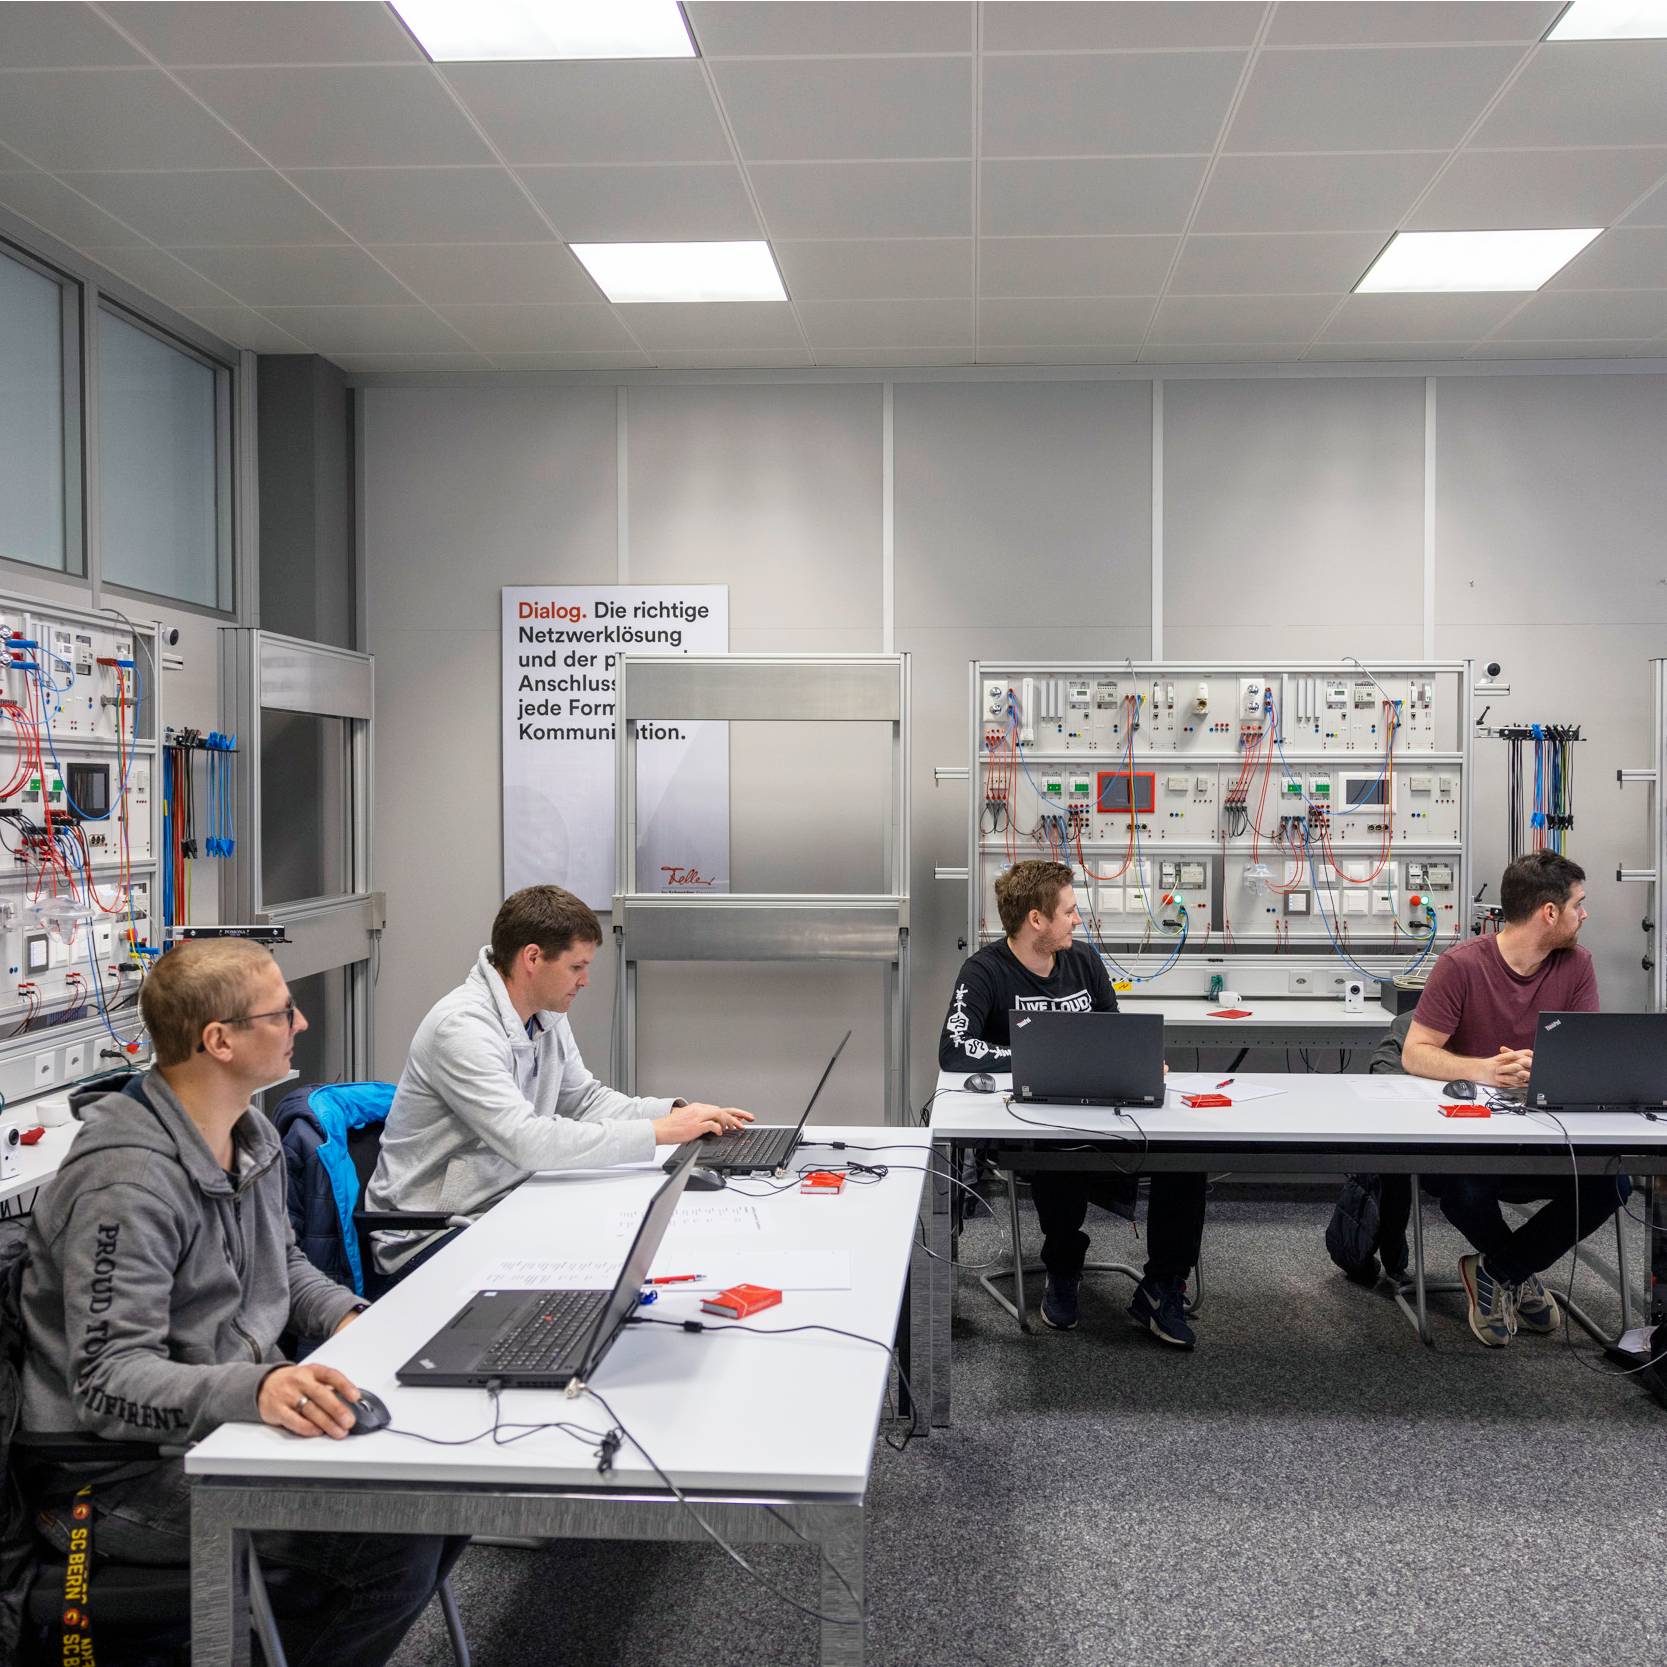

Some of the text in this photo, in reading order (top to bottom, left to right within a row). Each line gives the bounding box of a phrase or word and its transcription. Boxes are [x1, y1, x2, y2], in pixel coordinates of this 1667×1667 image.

[519, 601, 709, 623] Dialog. Die richtige
[519, 625, 682, 647] Netzwerklösung
[518, 650, 556, 667] und
[563, 650, 598, 667] der
[517, 698, 562, 720] jede
[519, 723, 686, 740] Kommunition.
[83, 1223, 119, 1355] PROUD TO
[65, 1528, 88, 1600] SC BERN
[63, 1634, 80, 1655] SC
